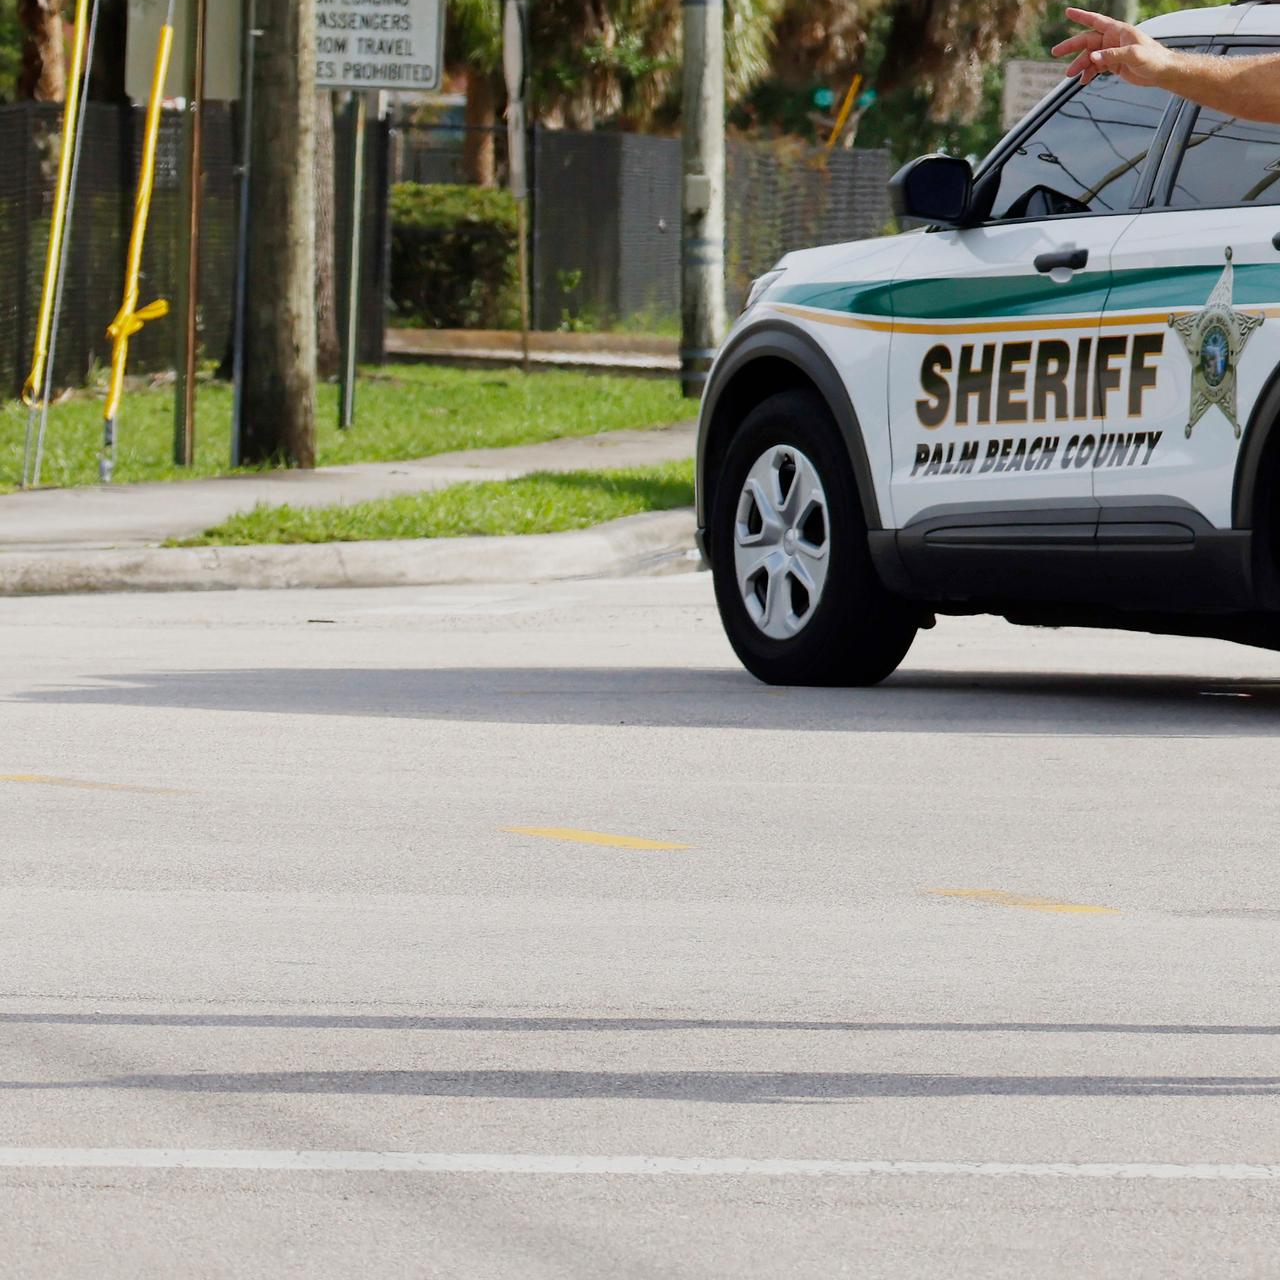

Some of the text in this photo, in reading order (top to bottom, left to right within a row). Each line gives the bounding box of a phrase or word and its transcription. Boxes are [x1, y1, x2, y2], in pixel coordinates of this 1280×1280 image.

[316, 37, 413, 56] ROM TRAVEL
[316, 60, 432, 82] ES PROHIBITED
[915, 331, 1165, 430] SHERIFF
[909, 430, 1163, 477] PALM BEACH COUNTY
